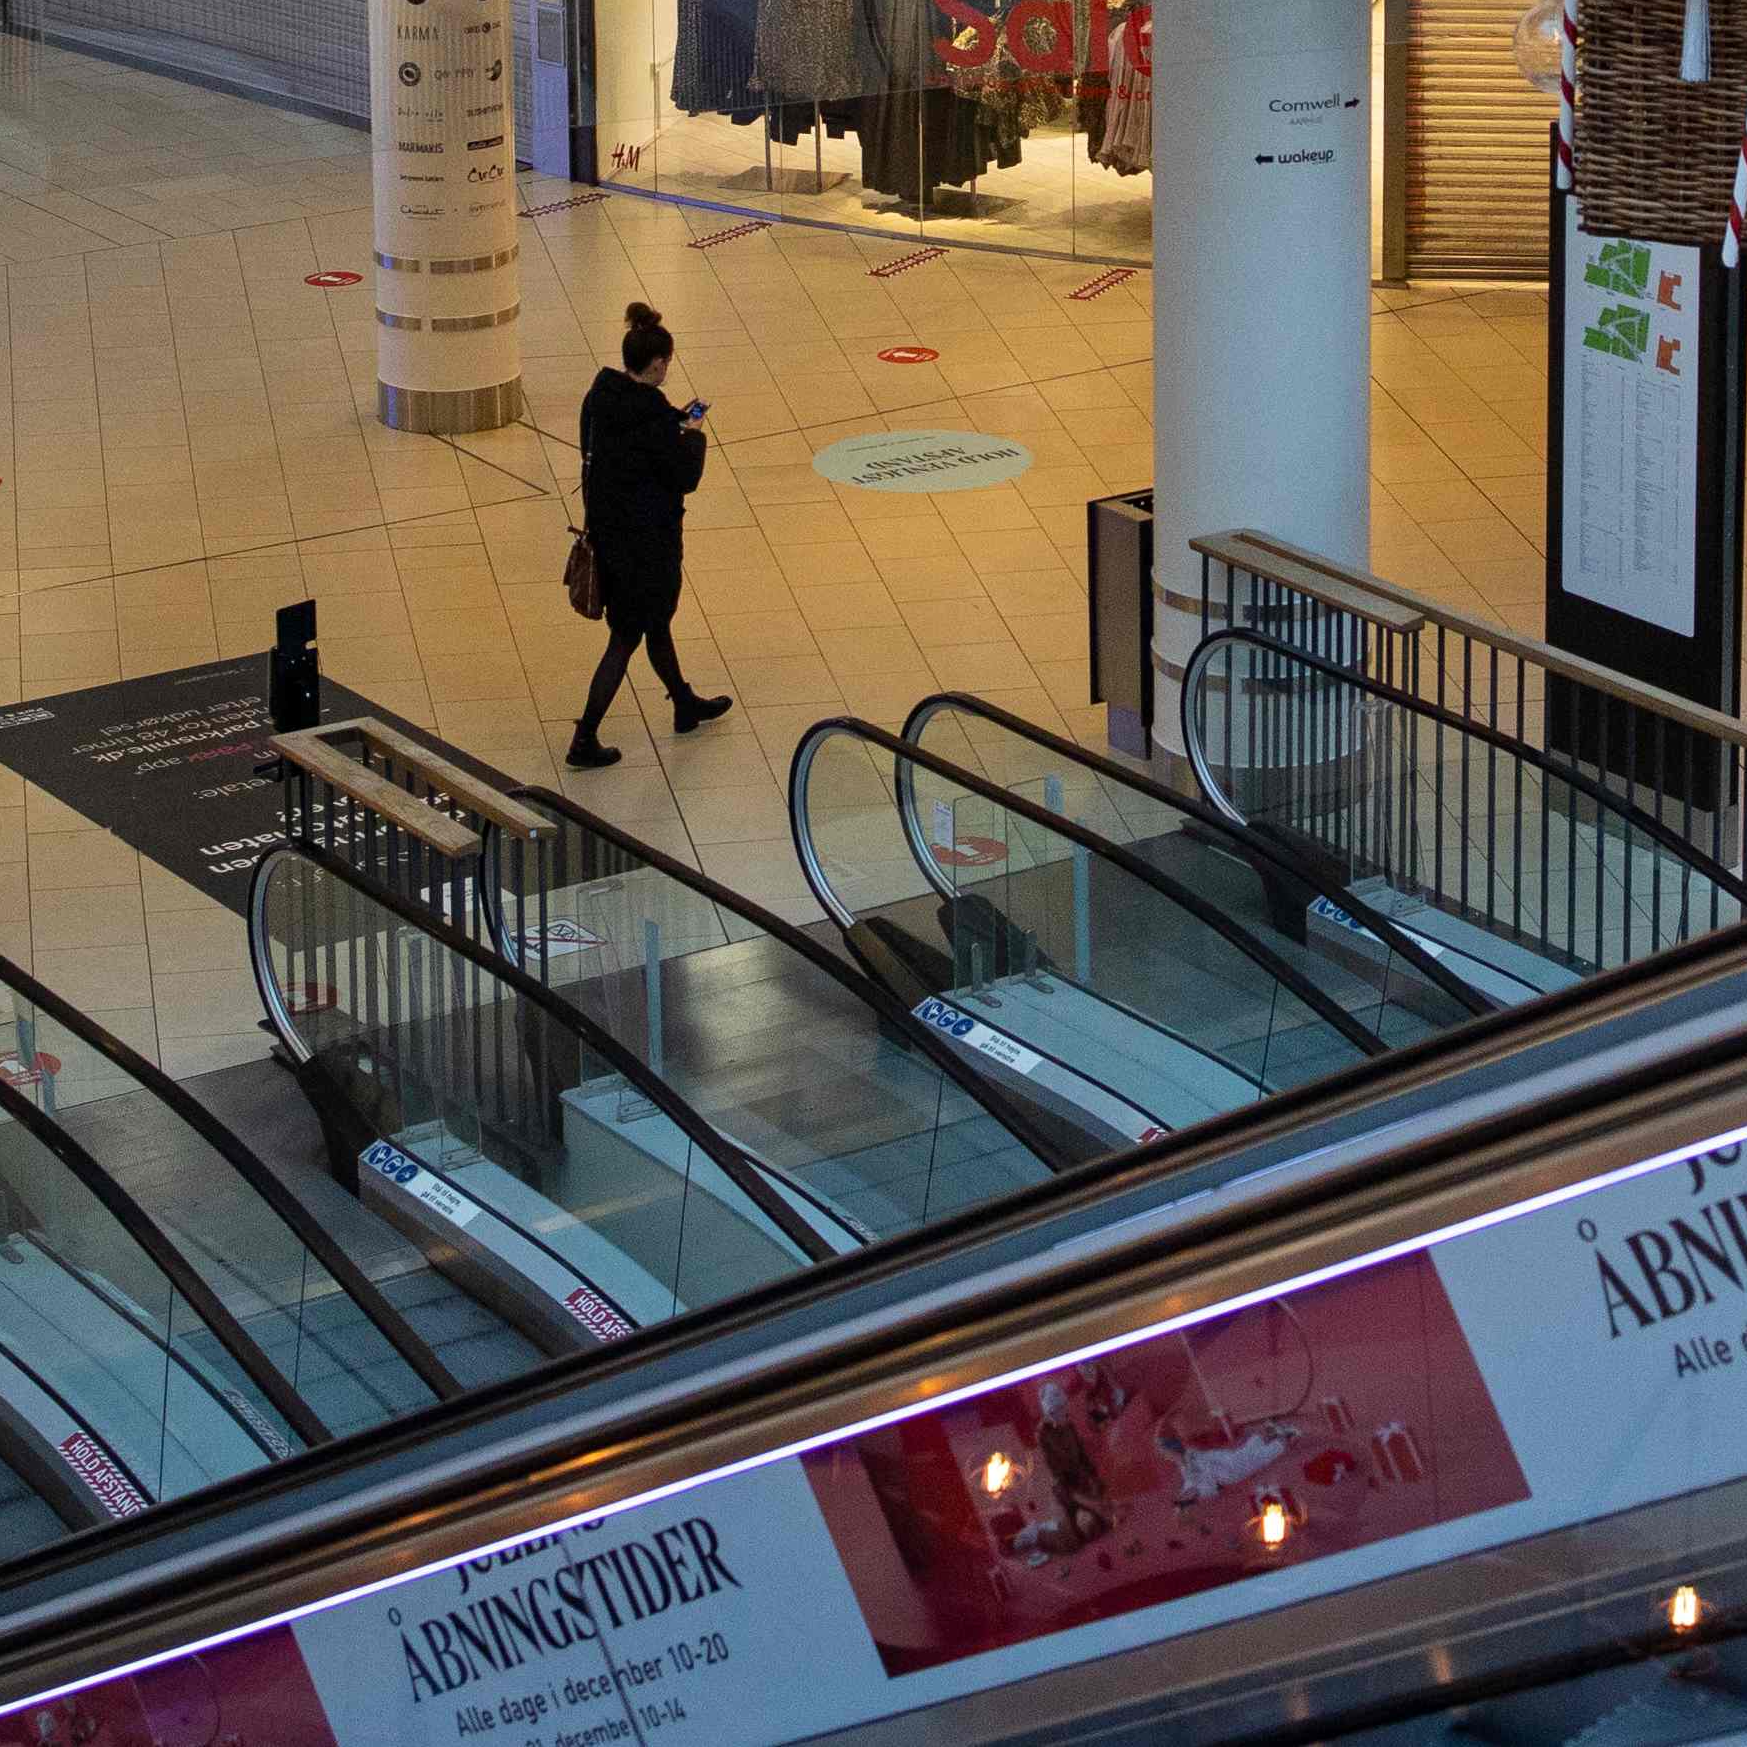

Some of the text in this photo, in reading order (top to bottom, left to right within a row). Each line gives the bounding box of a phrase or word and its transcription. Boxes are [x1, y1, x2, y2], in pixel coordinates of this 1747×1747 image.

[397, 25, 439, 41] KARMA
[1268, 92, 1340, 113] Comwell
[1278, 148, 1334, 164] wakeup
[958, 448, 1023, 465] HOLD
[574, 1294, 610, 1324] HOLD
[1673, 1328, 1734, 1378] Alle
[69, 1438, 141, 1518] HOLD AFSTAND
[387, 1516, 744, 1705] ÅBNINGSTIDER
[455, 1703, 496, 1738] Alle
[497, 1690, 550, 1728] dage
[666, 1631, 730, 1675] 10-20
[640, 1697, 688, 1732] 10-14
